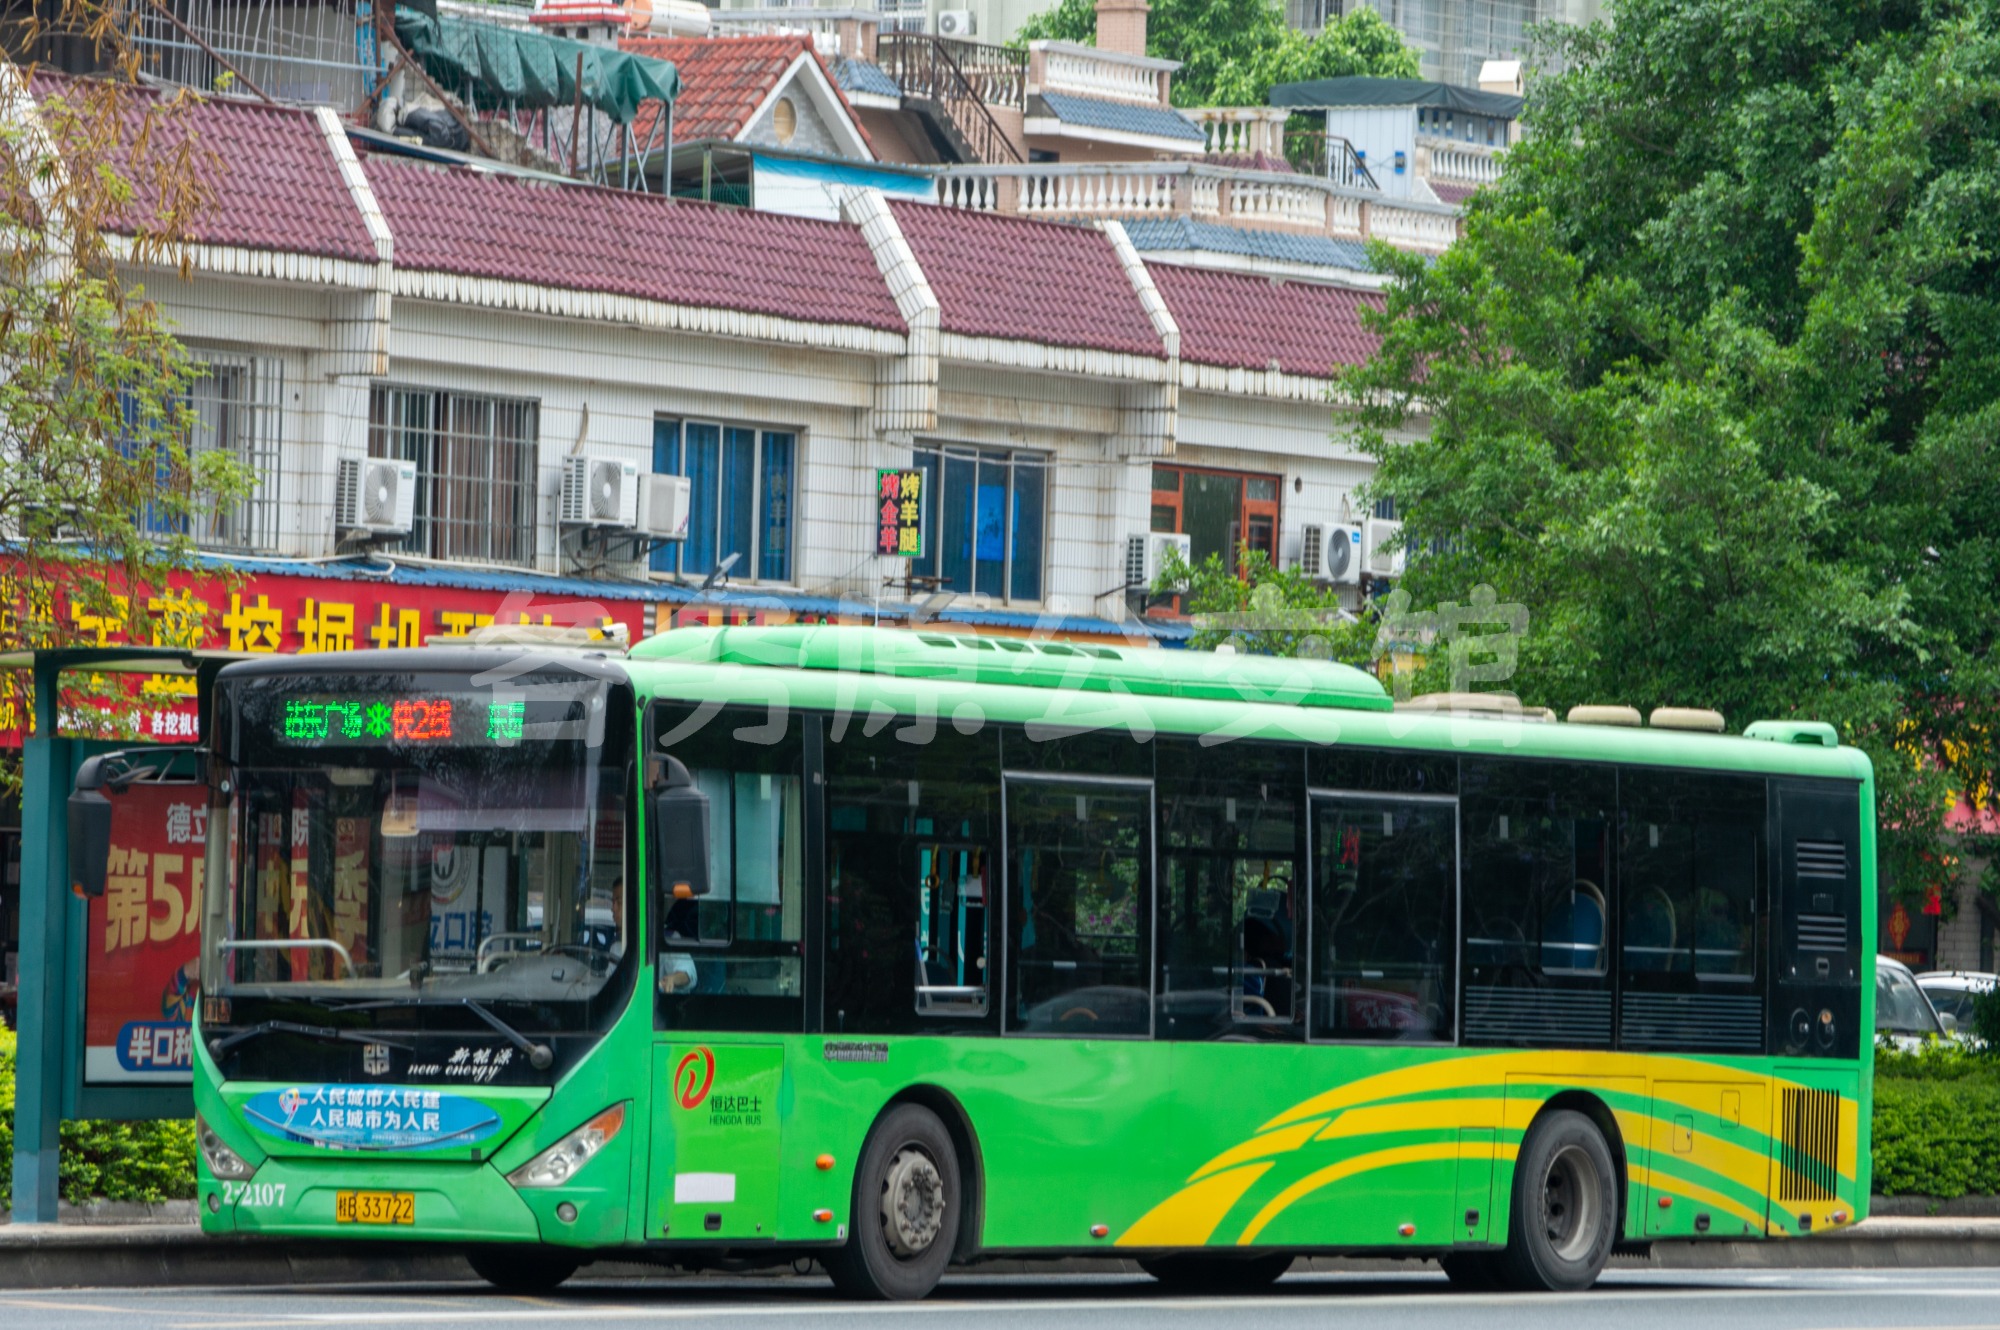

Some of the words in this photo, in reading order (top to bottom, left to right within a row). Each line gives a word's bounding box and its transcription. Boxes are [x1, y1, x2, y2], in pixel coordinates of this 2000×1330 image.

[880, 472, 900, 554] 烤全羊
[899, 471, 920, 552] 烤羊腿
[449, 1046, 513, 1065] 新能源
[407, 1063, 442, 1077] new
[445, 1064, 501, 1083] energy
[311, 1087, 441, 1110] 人民城市人民建
[709, 1095, 762, 1114] 恒达巴士
[311, 1108, 440, 1132] 人民城市为人民
[709, 1114, 742, 1126] HENGDA
[745, 1115, 762, 1126] BUS
